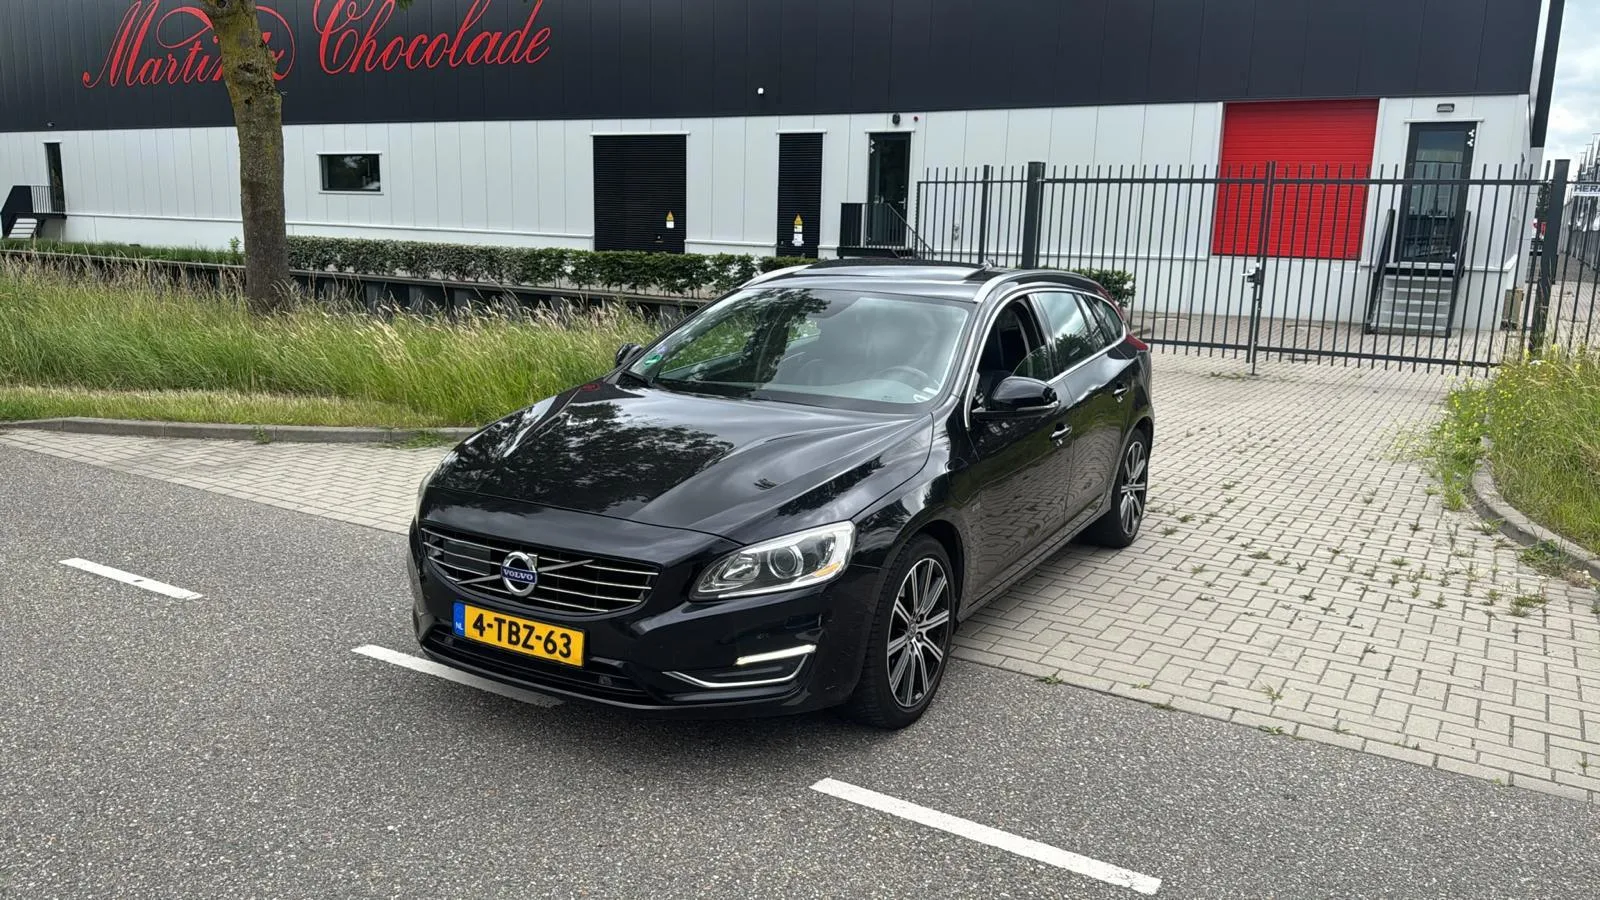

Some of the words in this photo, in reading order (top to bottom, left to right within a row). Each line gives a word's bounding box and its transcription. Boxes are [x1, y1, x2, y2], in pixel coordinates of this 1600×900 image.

[313, 0, 550, 74] Chocolade
[503, 568, 534, 581] VOLVO
[455, 621, 464, 631] NL
[472, 613, 572, 659] 4-TBZ-63
